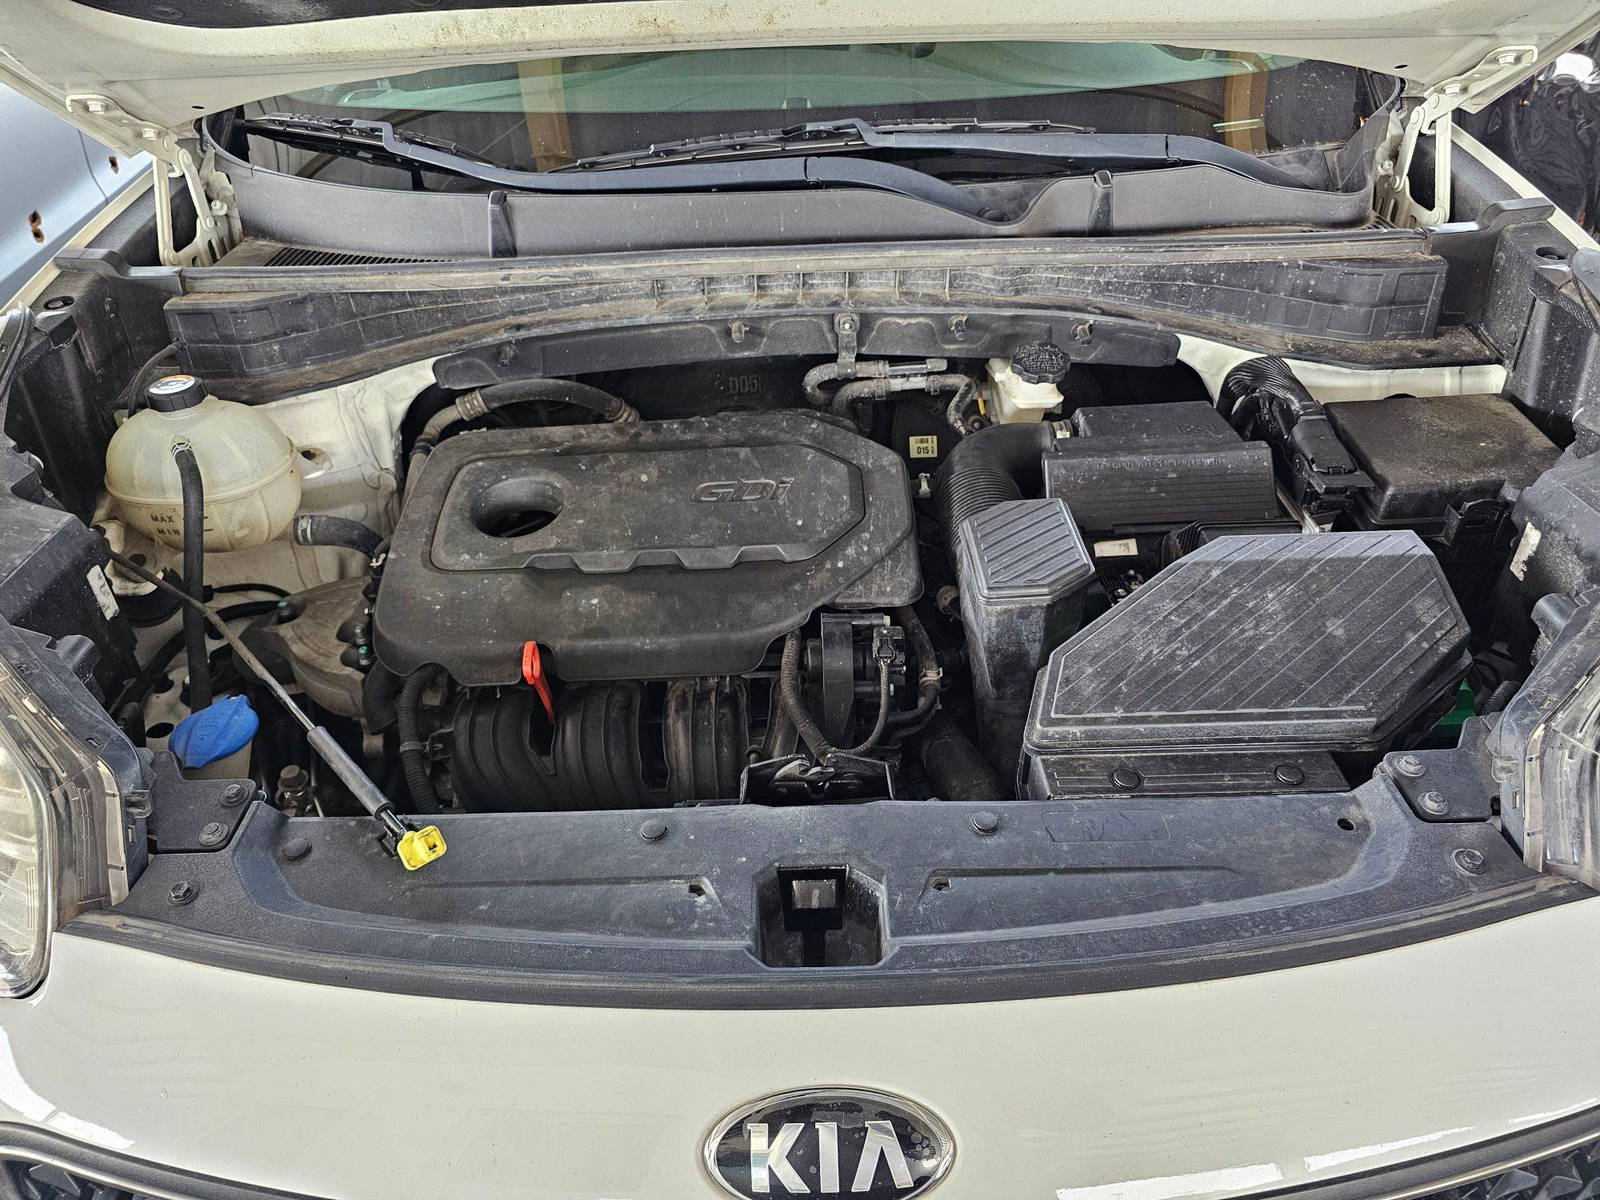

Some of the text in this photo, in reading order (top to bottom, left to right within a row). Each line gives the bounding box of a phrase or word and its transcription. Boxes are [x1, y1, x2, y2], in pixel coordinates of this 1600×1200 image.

[150, 514, 175, 523] MAX
[156, 528, 181, 536] MIN
[747, 1120, 914, 1194] KIA
